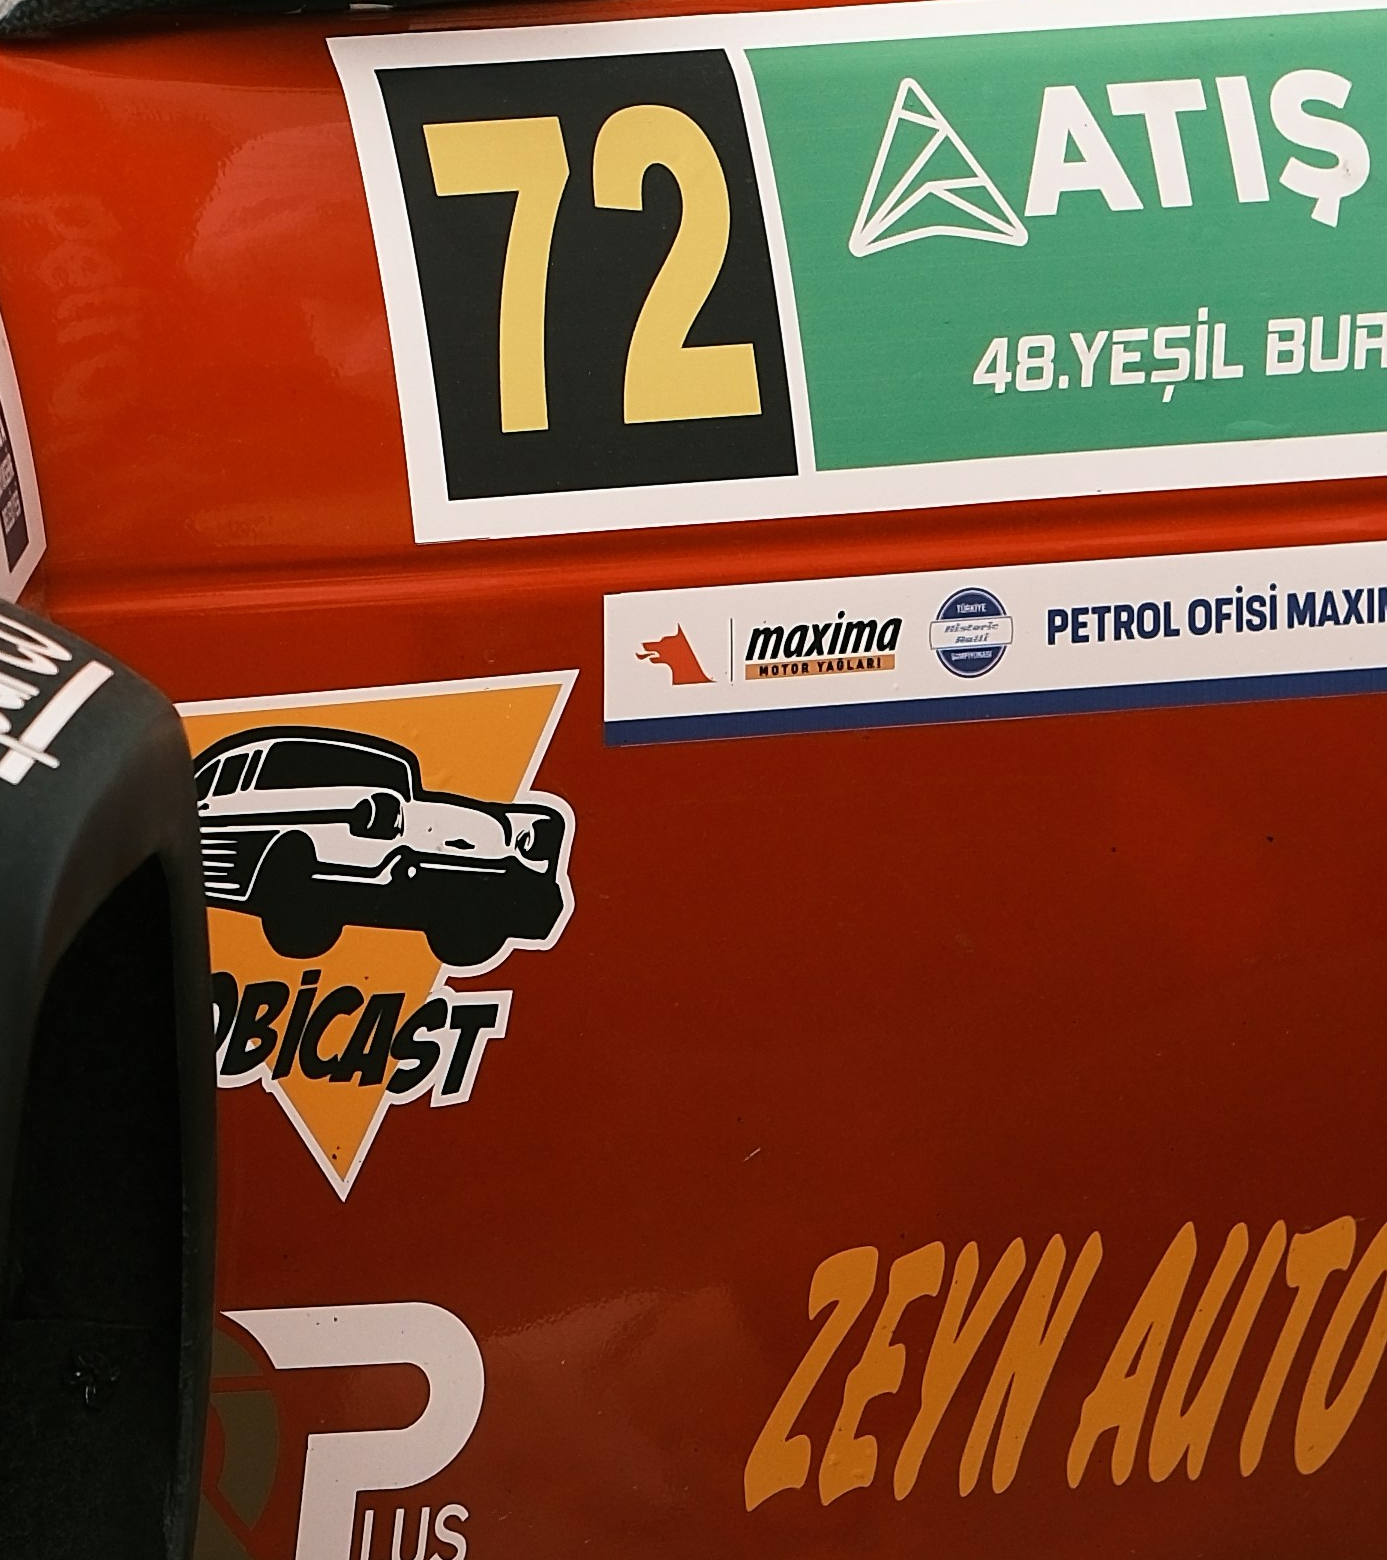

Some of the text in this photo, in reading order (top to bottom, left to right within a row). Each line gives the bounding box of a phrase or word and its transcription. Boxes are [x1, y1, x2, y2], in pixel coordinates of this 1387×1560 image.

[1024, 68, 1371, 228] ATIŞ
[422, 103, 762, 435] 72
[972, 306, 1387, 403] 48.YEŞİL BUR
[744, 610, 903, 661] maxima
[1046, 600, 1181, 646] PETROL
[1187, 582, 1278, 636] OFİSİ
[758, 657, 882, 677] MOTOR YAĞLARI
[743, 1214, 1387, 1512] ZEYN AUTO
